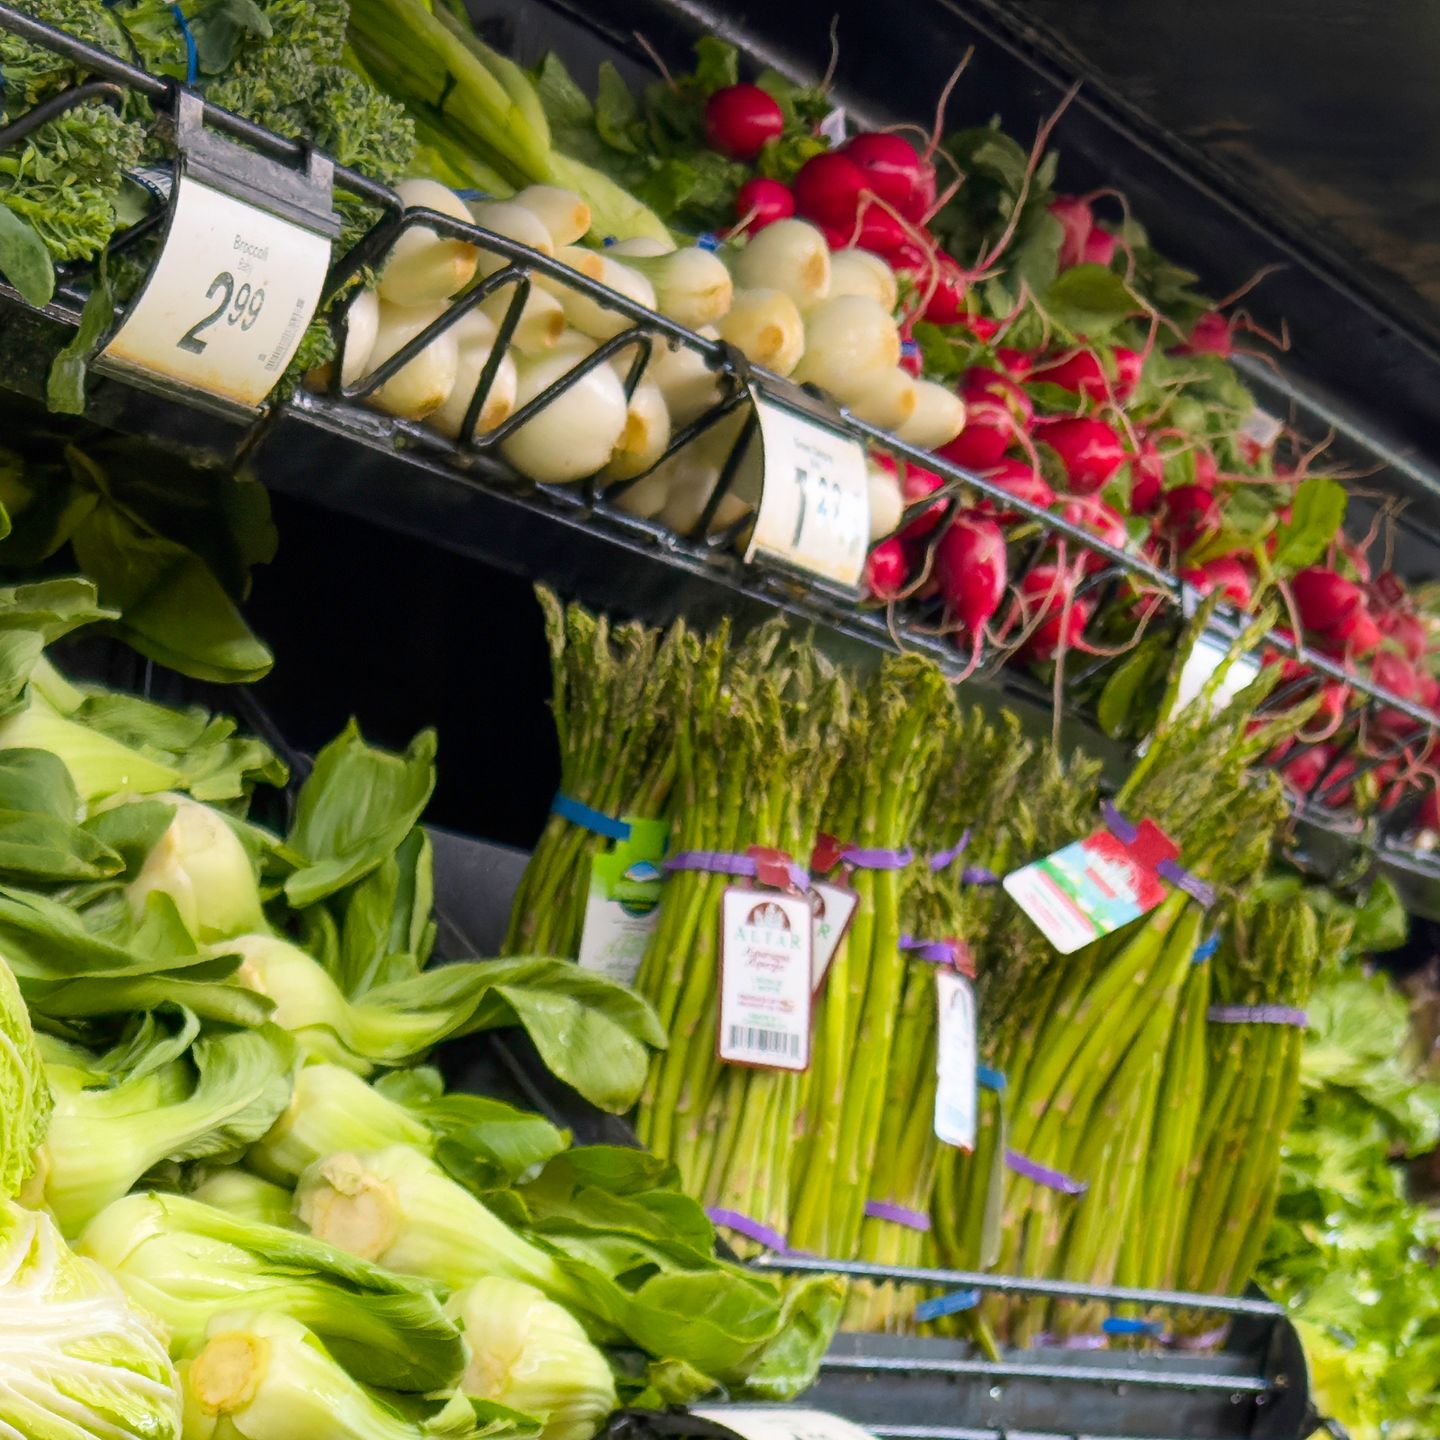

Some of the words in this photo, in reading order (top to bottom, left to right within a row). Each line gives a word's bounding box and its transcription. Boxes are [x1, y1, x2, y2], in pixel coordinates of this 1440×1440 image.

[233, 234, 270, 262] Broccoli
[176, 271, 235, 355] 2
[227, 283, 265, 332] 99
